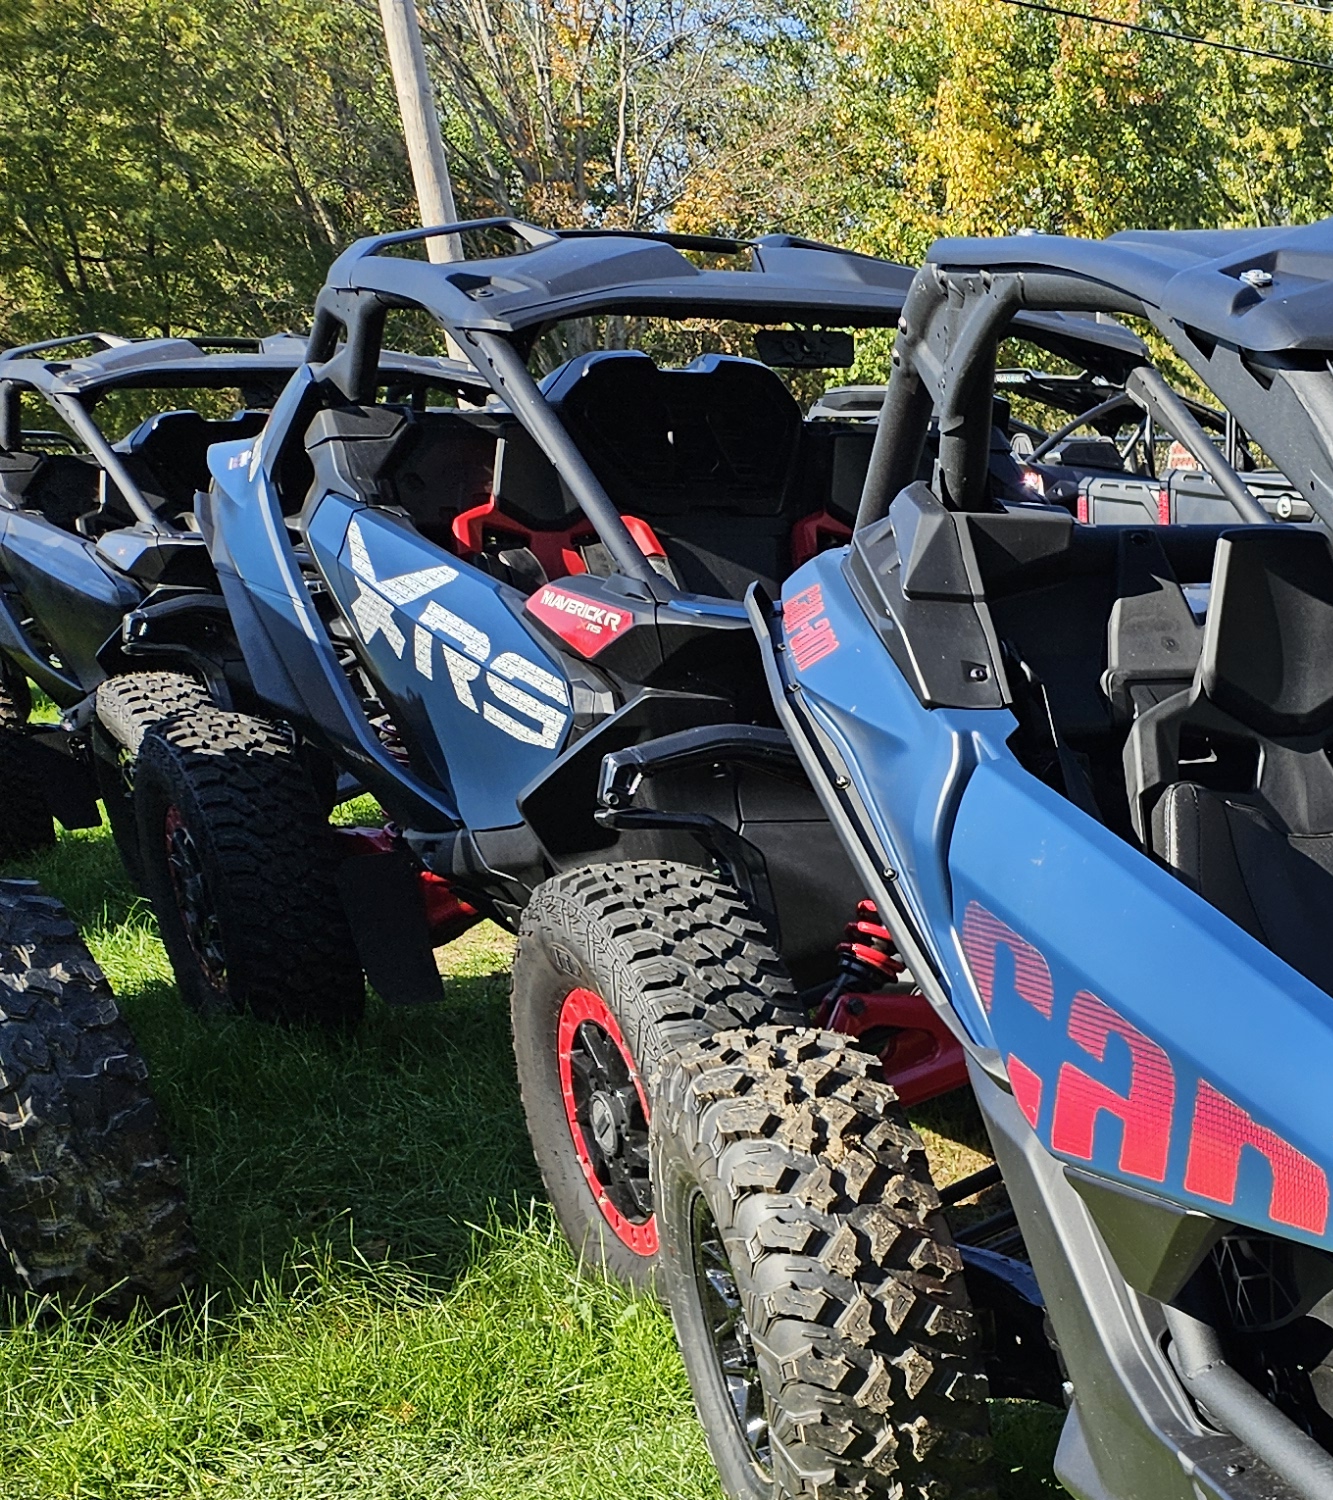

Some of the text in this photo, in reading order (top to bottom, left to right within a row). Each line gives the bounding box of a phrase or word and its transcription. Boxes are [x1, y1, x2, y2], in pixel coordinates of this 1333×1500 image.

[347, 519, 569, 750] XRS
[540, 589, 621, 632] MAVERICK R
